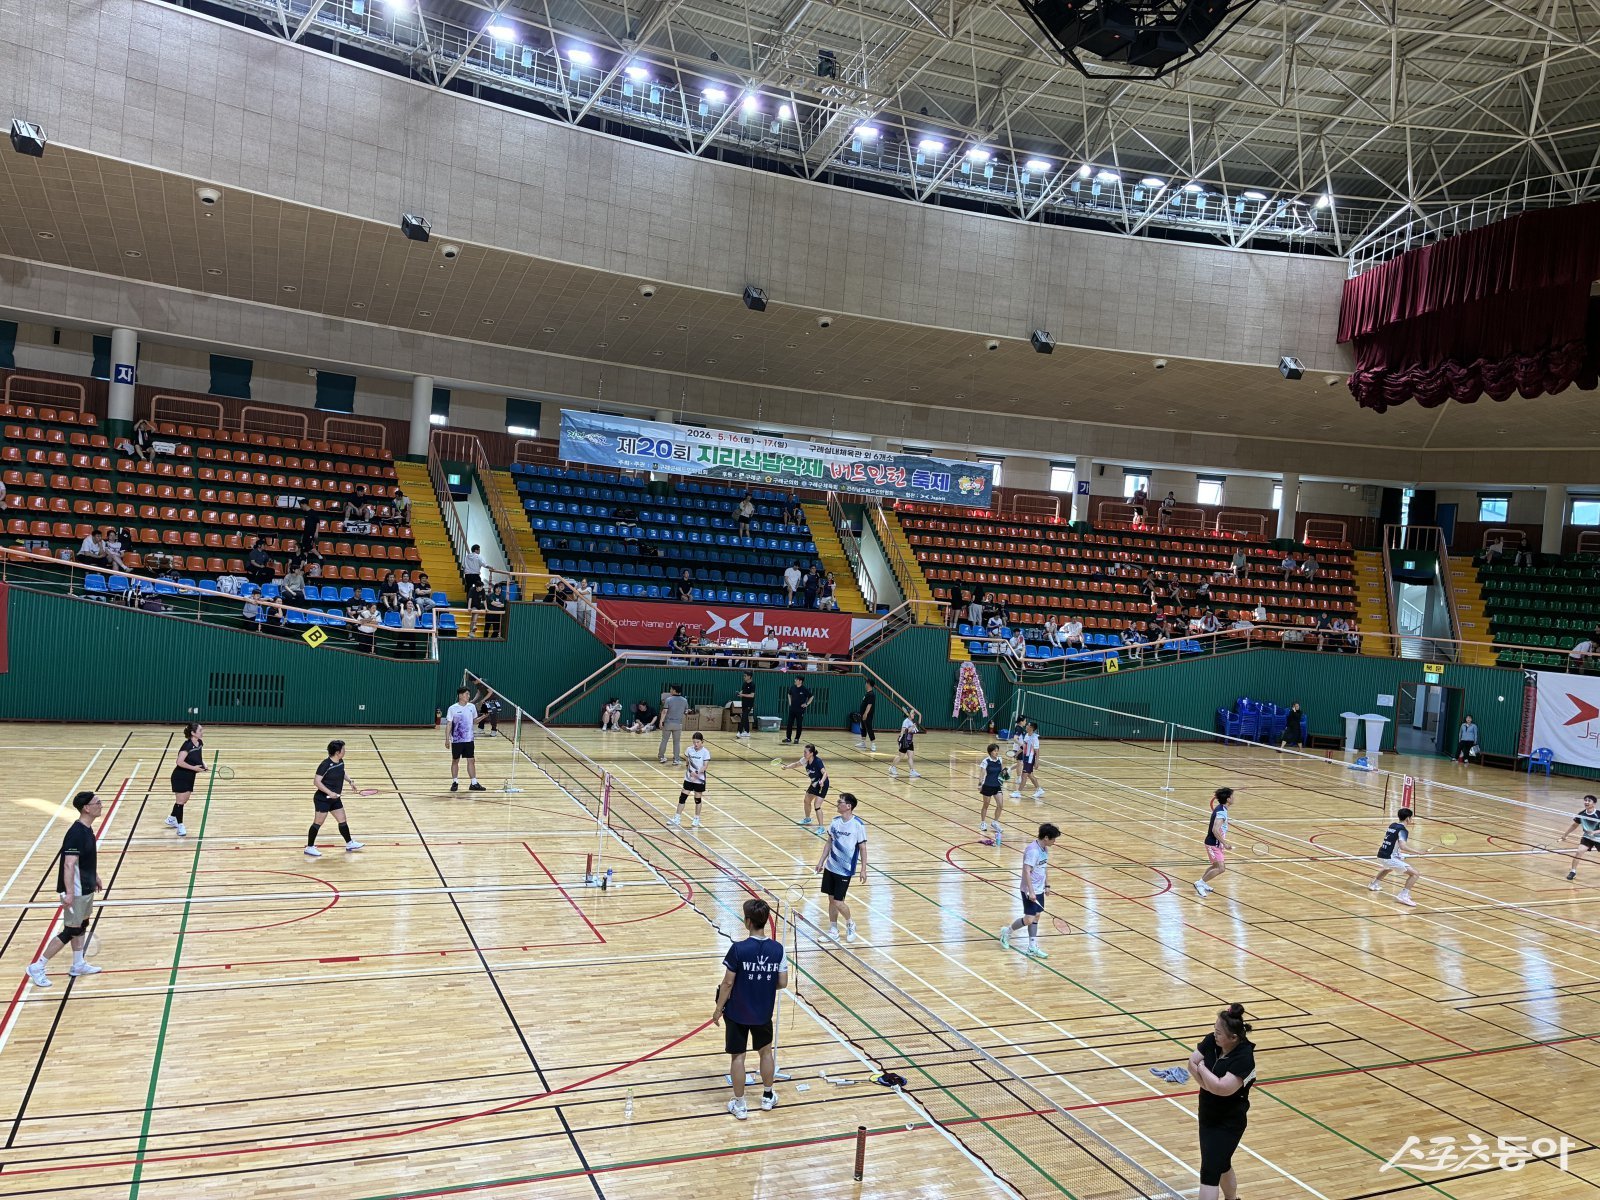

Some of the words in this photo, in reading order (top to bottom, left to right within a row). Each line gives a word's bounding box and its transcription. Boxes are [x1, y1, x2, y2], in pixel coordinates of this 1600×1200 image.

[117, 366, 133, 382] 자
[687, 428, 713, 440] 2026.
[718, 433, 726, 441] 5.
[808, 444, 862, 459] 구례실내체육관
[864, 451, 872, 460] 외
[873, 453, 895, 462] 6개소
[616, 436, 692, 463] 제20회
[696, 444, 824, 479] 지리산남악제
[830, 461, 907, 488] 배드민턴
[911, 469, 951, 493] 축제
[746, 474, 762, 482] 구례군
[773, 477, 799, 486] 구례군의회
[808, 481, 838, 491] 구례군체육회
[618, 618, 641, 628] other
[641, 620, 665, 629] Name
[665, 621, 674, 630] of
[763, 624, 830, 639] DURAMAX
[308, 629, 323, 642] B
[1109, 659, 1117, 670] A
